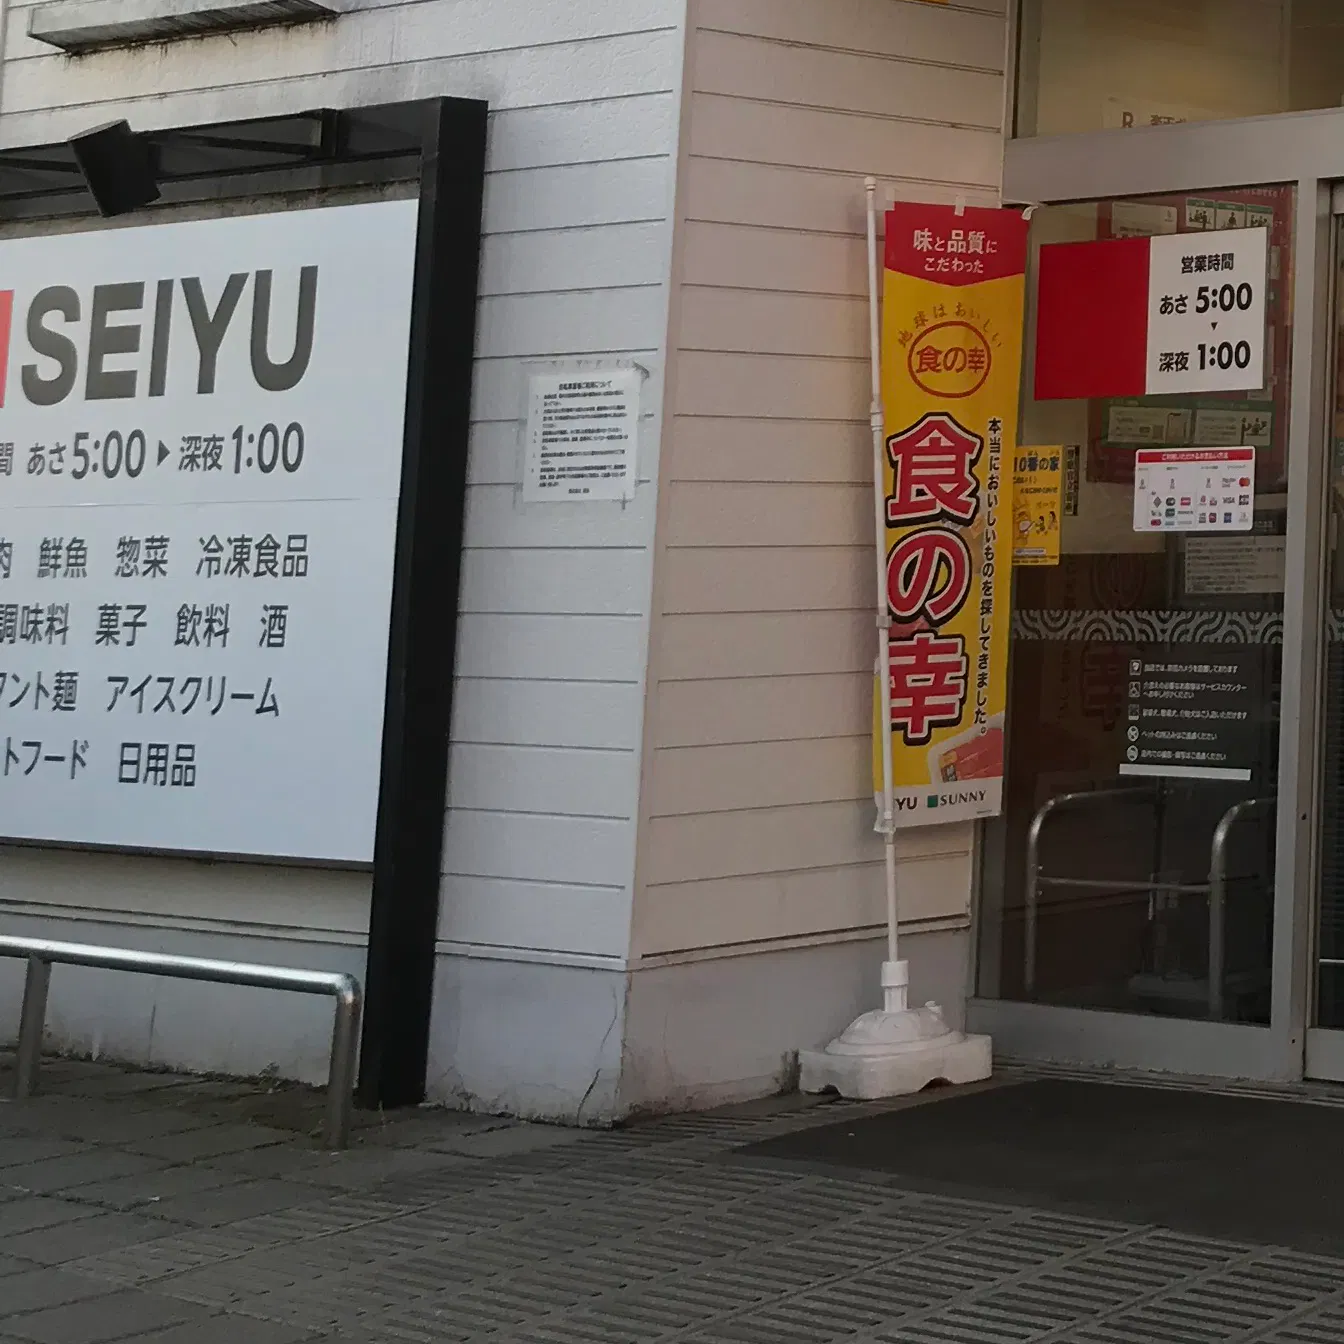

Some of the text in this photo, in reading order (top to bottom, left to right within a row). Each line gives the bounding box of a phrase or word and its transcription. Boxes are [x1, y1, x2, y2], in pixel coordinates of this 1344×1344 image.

[913, 227, 998, 254] 味と品質に
[923, 257, 984, 273] こだわった
[1181, 253, 1235, 274] 営業時間
[21, 265, 319, 406] SEIYU
[915, 344, 986, 375] 食の幸
[37, 537, 88, 579] 鮮魚
[114, 536, 170, 579] 惣菜
[196, 533, 309, 578] 冷凍食品
[885, 411, 984, 746] 食の幸
[95, 604, 148, 647] 菓子
[174, 603, 230, 648] 飲料
[259, 605, 289, 648] 酒
[106, 674, 281, 717] アイスクリーム
[118, 742, 197, 787] 日用品
[940, 790, 987, 805] SUNNY
